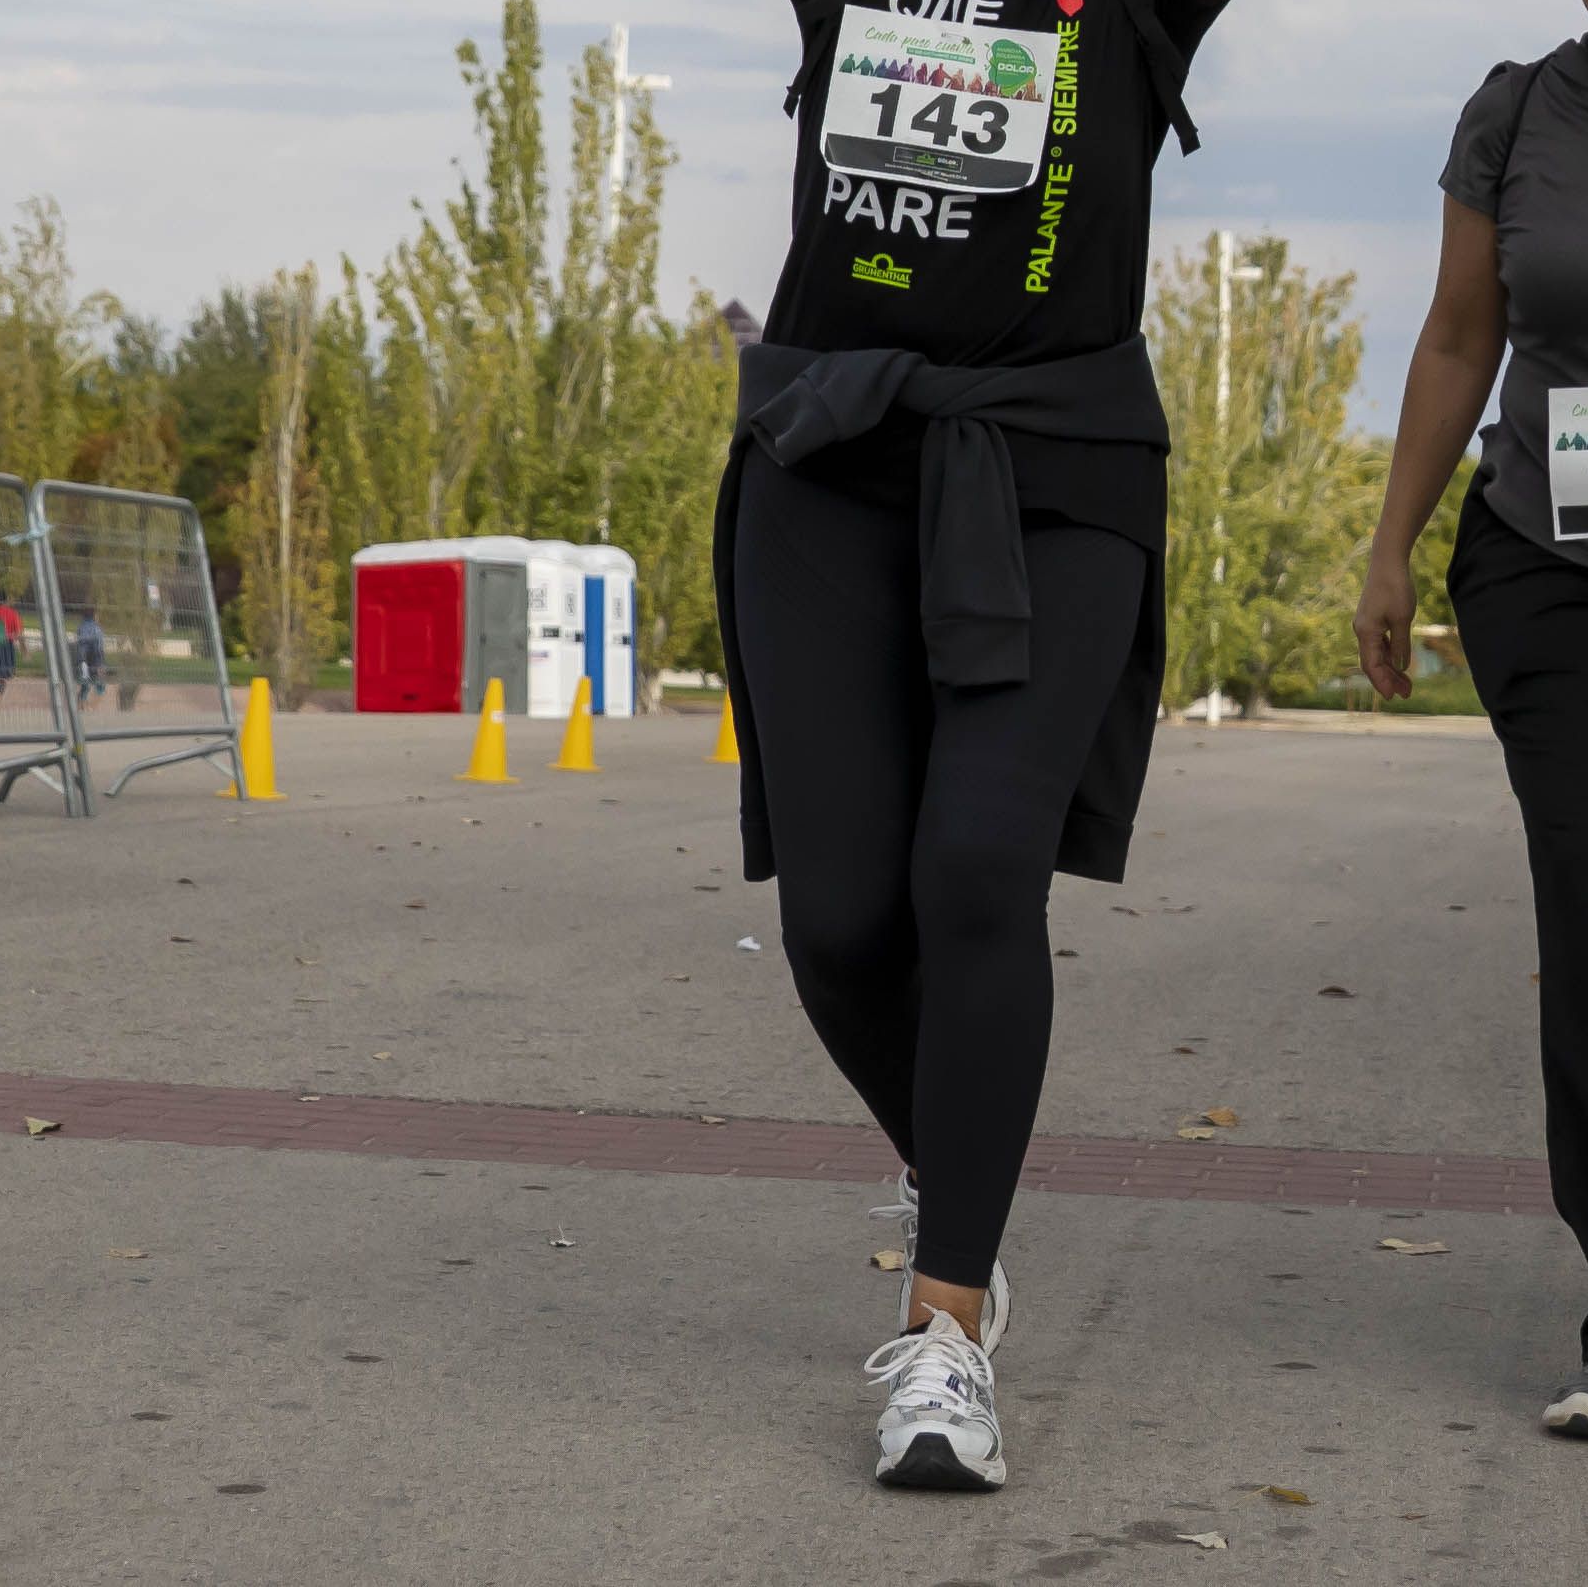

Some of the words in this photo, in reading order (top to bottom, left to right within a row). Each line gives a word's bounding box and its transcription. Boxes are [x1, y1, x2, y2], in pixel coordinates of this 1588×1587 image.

[870, 83, 1010, 155] 143
[1025, 163, 1074, 293] PALANTE
[1052, 20, 1080, 135] SIEMPRE
[824, 171, 977, 238] PARE
